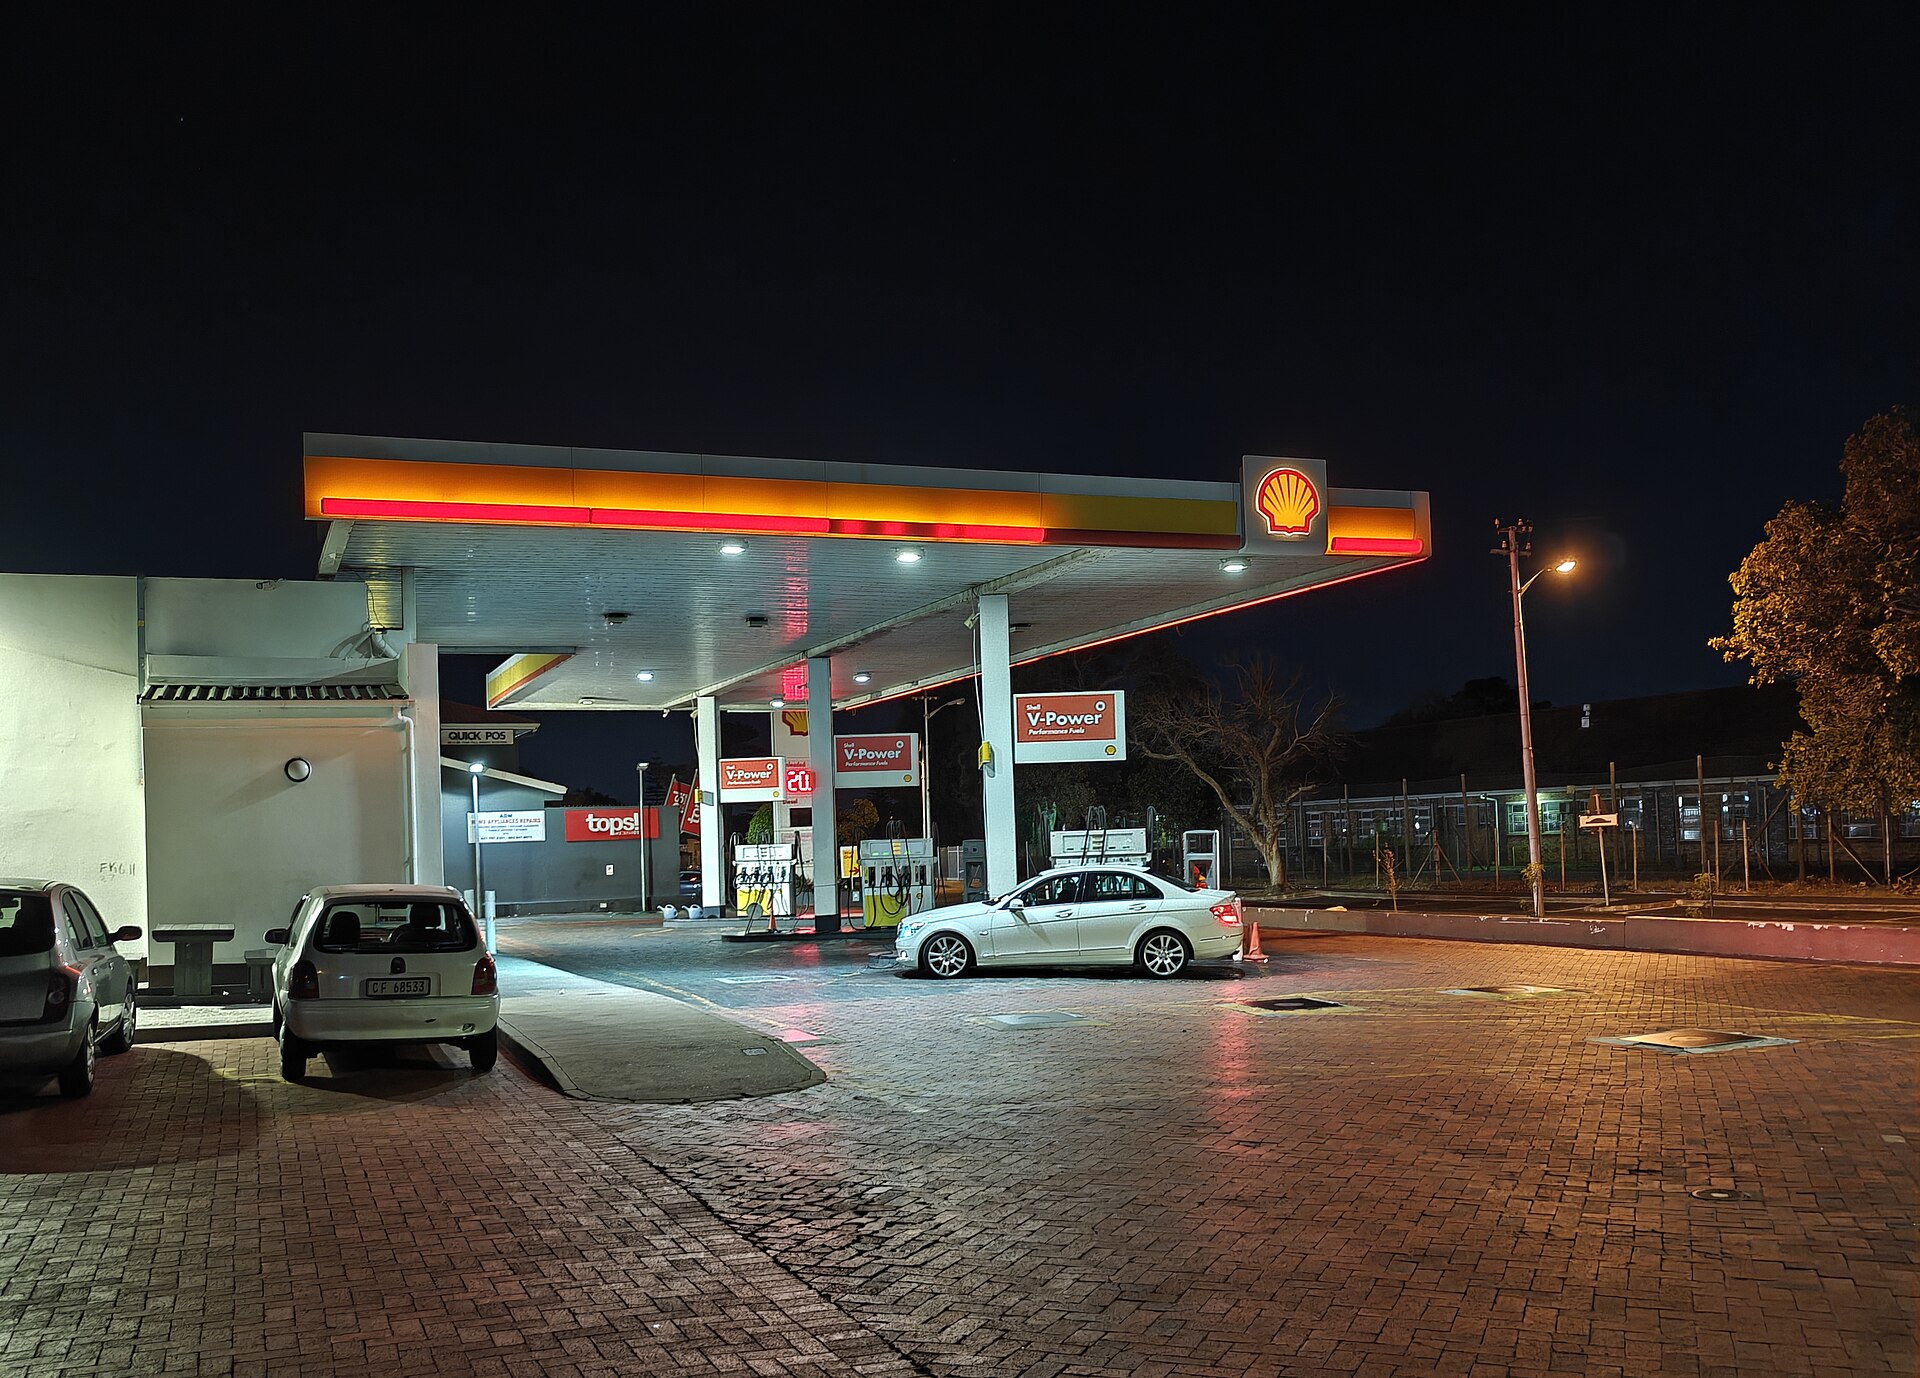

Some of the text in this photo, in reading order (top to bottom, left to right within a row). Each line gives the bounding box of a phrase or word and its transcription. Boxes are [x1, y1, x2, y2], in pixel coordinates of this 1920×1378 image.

[1026, 712, 1103, 727] V-Power
[448, 731, 506, 741] QUICK POS
[844, 748, 901, 760] V-Power
[726, 770, 772, 780] V-Power
[585, 812, 639, 836] tops!
[372, 981, 425, 995] CF 68533
